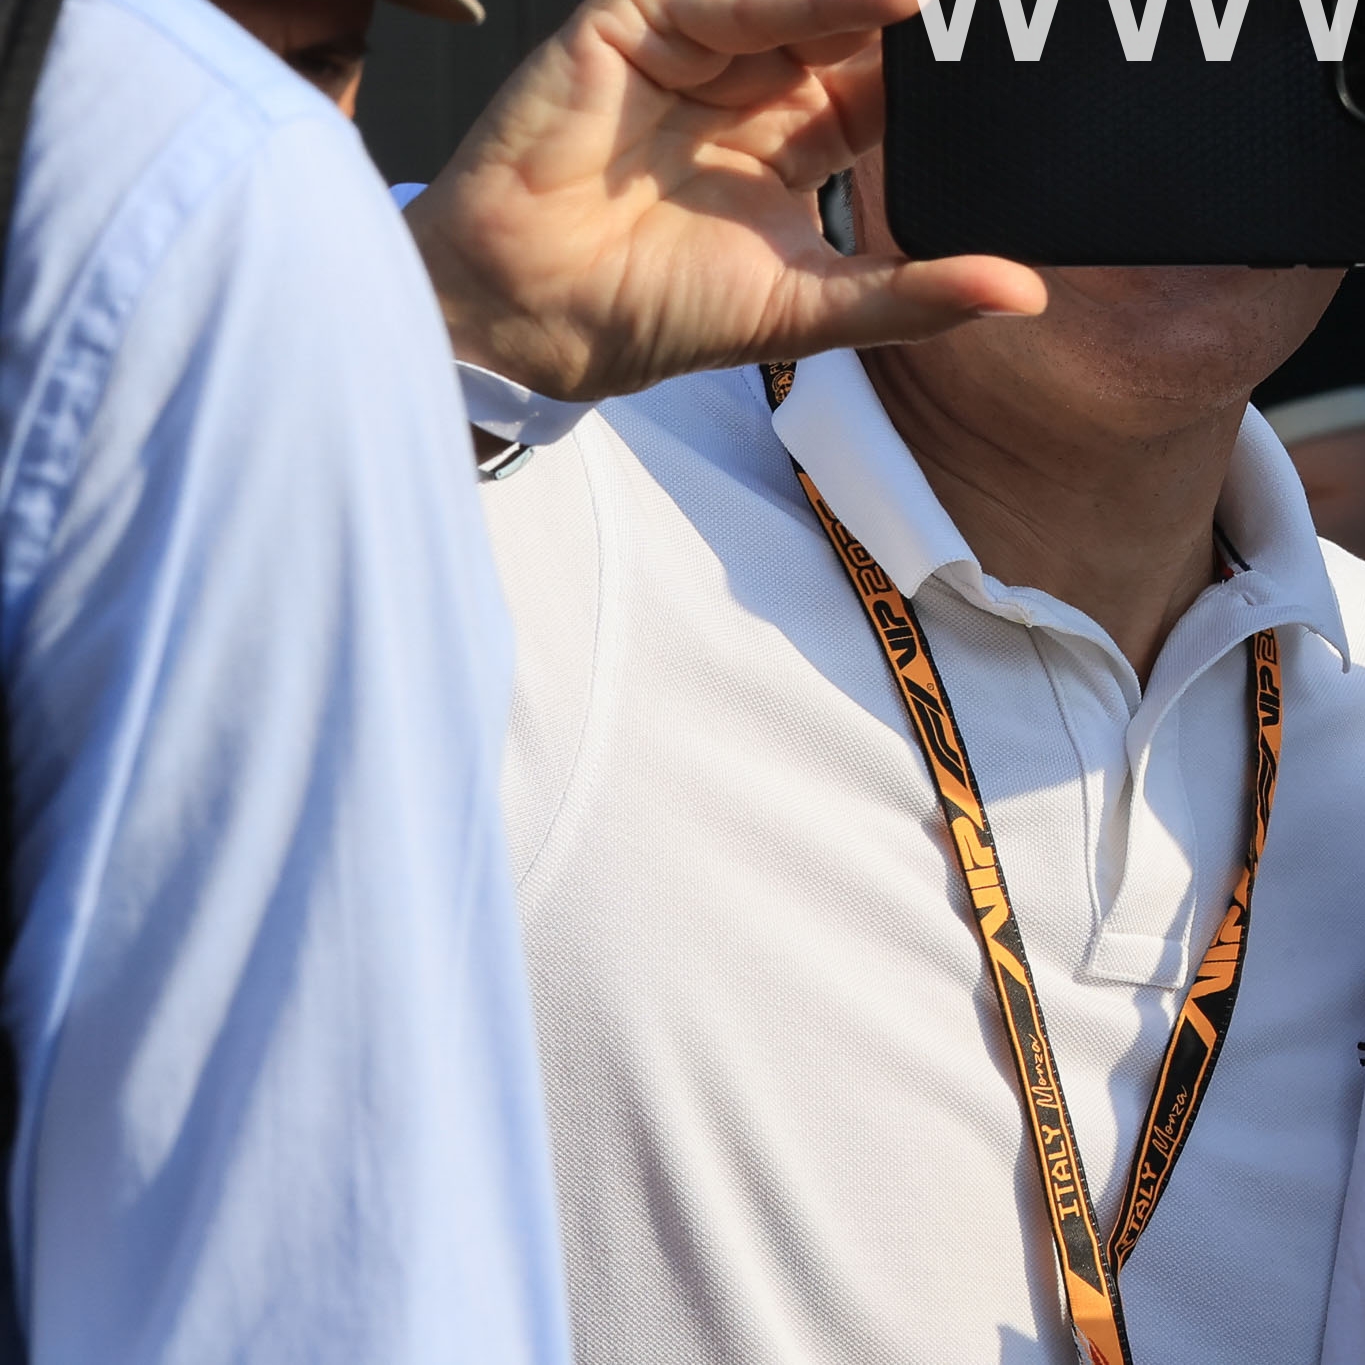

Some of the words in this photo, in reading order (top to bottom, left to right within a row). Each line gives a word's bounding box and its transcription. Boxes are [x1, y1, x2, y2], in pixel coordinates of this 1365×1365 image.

[872, 599, 918, 671] VIP
[1259, 665, 1280, 727] VIP
[952, 817, 1010, 936] VIP
[1029, 1033, 1061, 1111] Monza
[1040, 1123, 1080, 1221] ITALY
[1120, 1161, 1157, 1250] ITALY
[1152, 1084, 1188, 1160] Monza
